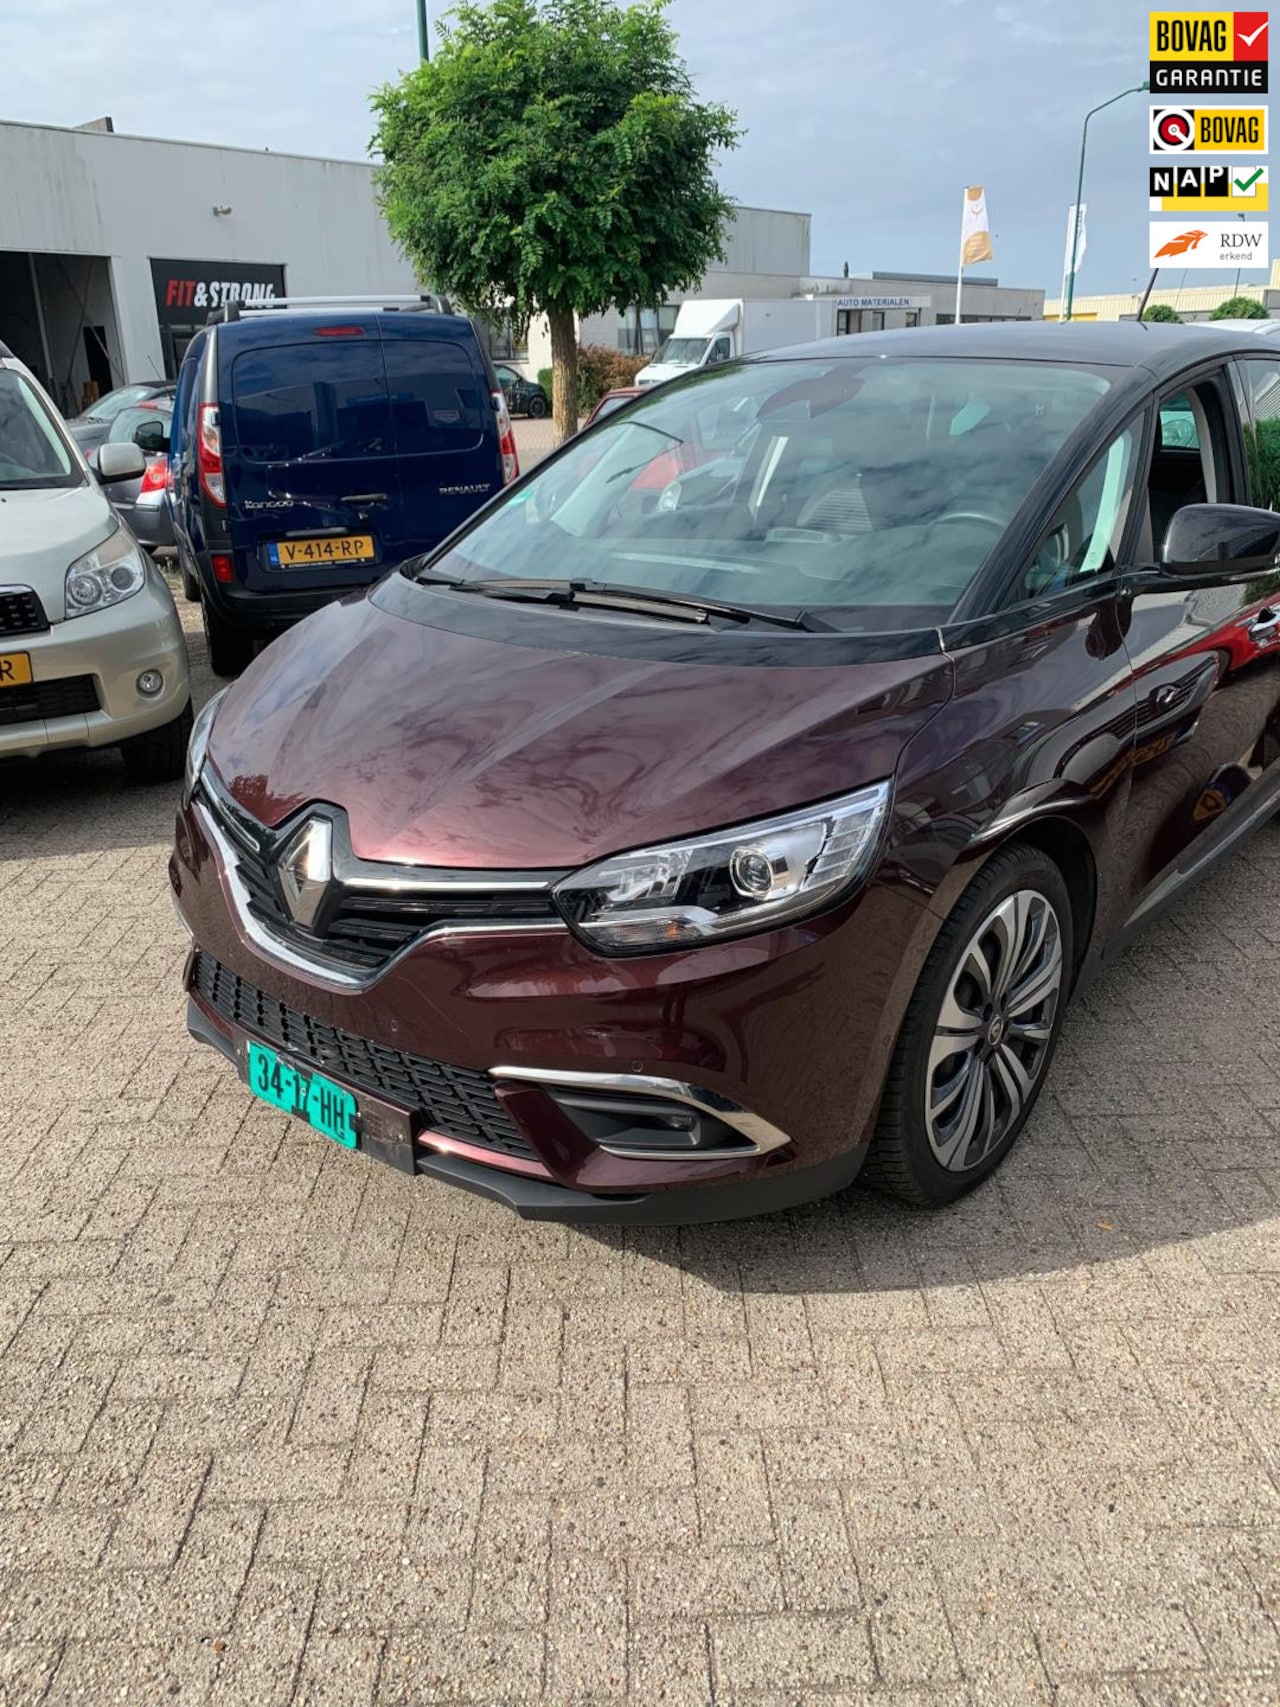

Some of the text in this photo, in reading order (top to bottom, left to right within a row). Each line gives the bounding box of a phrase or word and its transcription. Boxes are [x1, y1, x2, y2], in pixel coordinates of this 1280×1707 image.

[837, 297, 910, 307] AUTO MATERIALEN
[439, 483, 490, 495] RENAULT
[285, 540, 363, 560] V-414-RP
